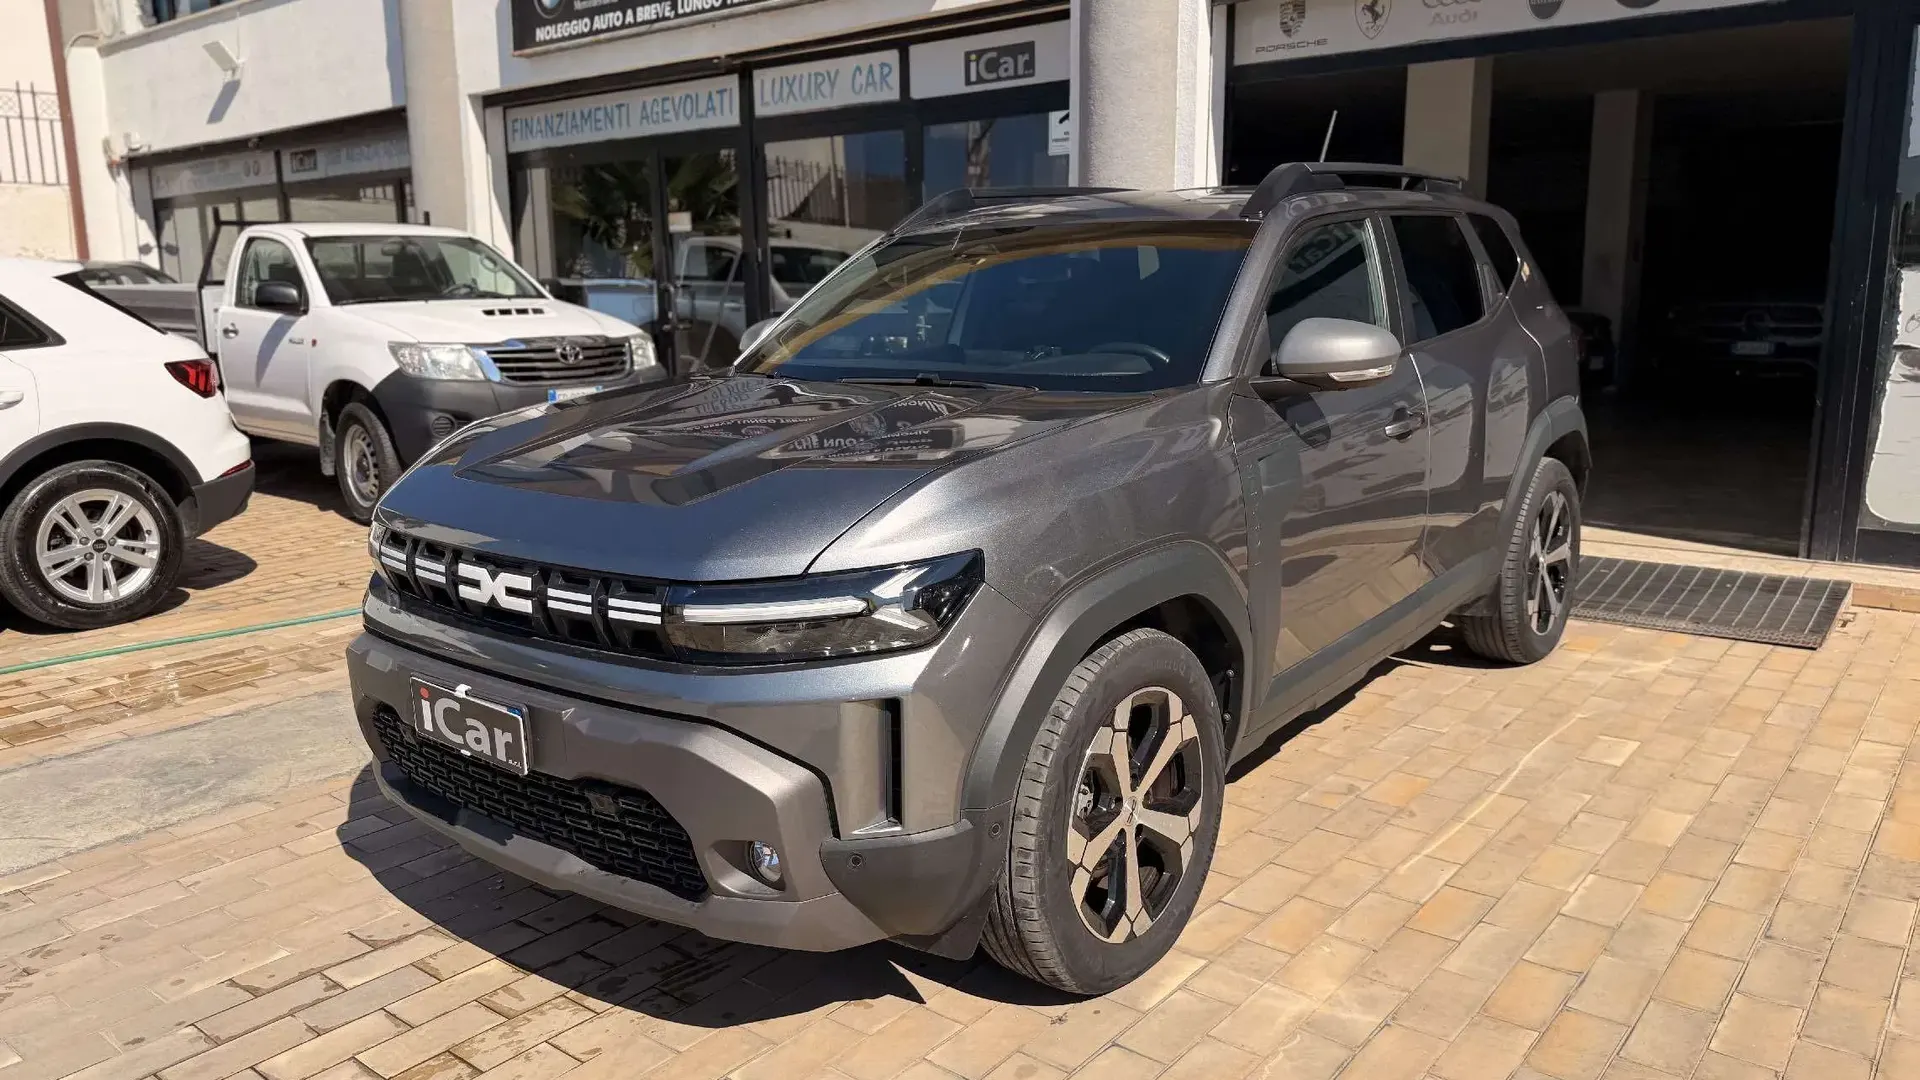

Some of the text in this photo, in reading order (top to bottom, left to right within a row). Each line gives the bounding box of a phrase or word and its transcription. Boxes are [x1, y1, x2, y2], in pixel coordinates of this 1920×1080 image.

[535, 17, 591, 42] NOLEGGIO
[592, 11, 623, 31] AUTO
[624, 9, 635, 25] A
[636, 1, 675, 21] BREVE,
[968, 50, 1031, 82] iCar
[1255, 38, 1329, 54] PORSCHE
[760, 61, 894, 107] LUXURY CAR
[510, 87, 734, 143] FINANZIAMENTI AGEVOLATI
[419, 686, 513, 762] iCar
